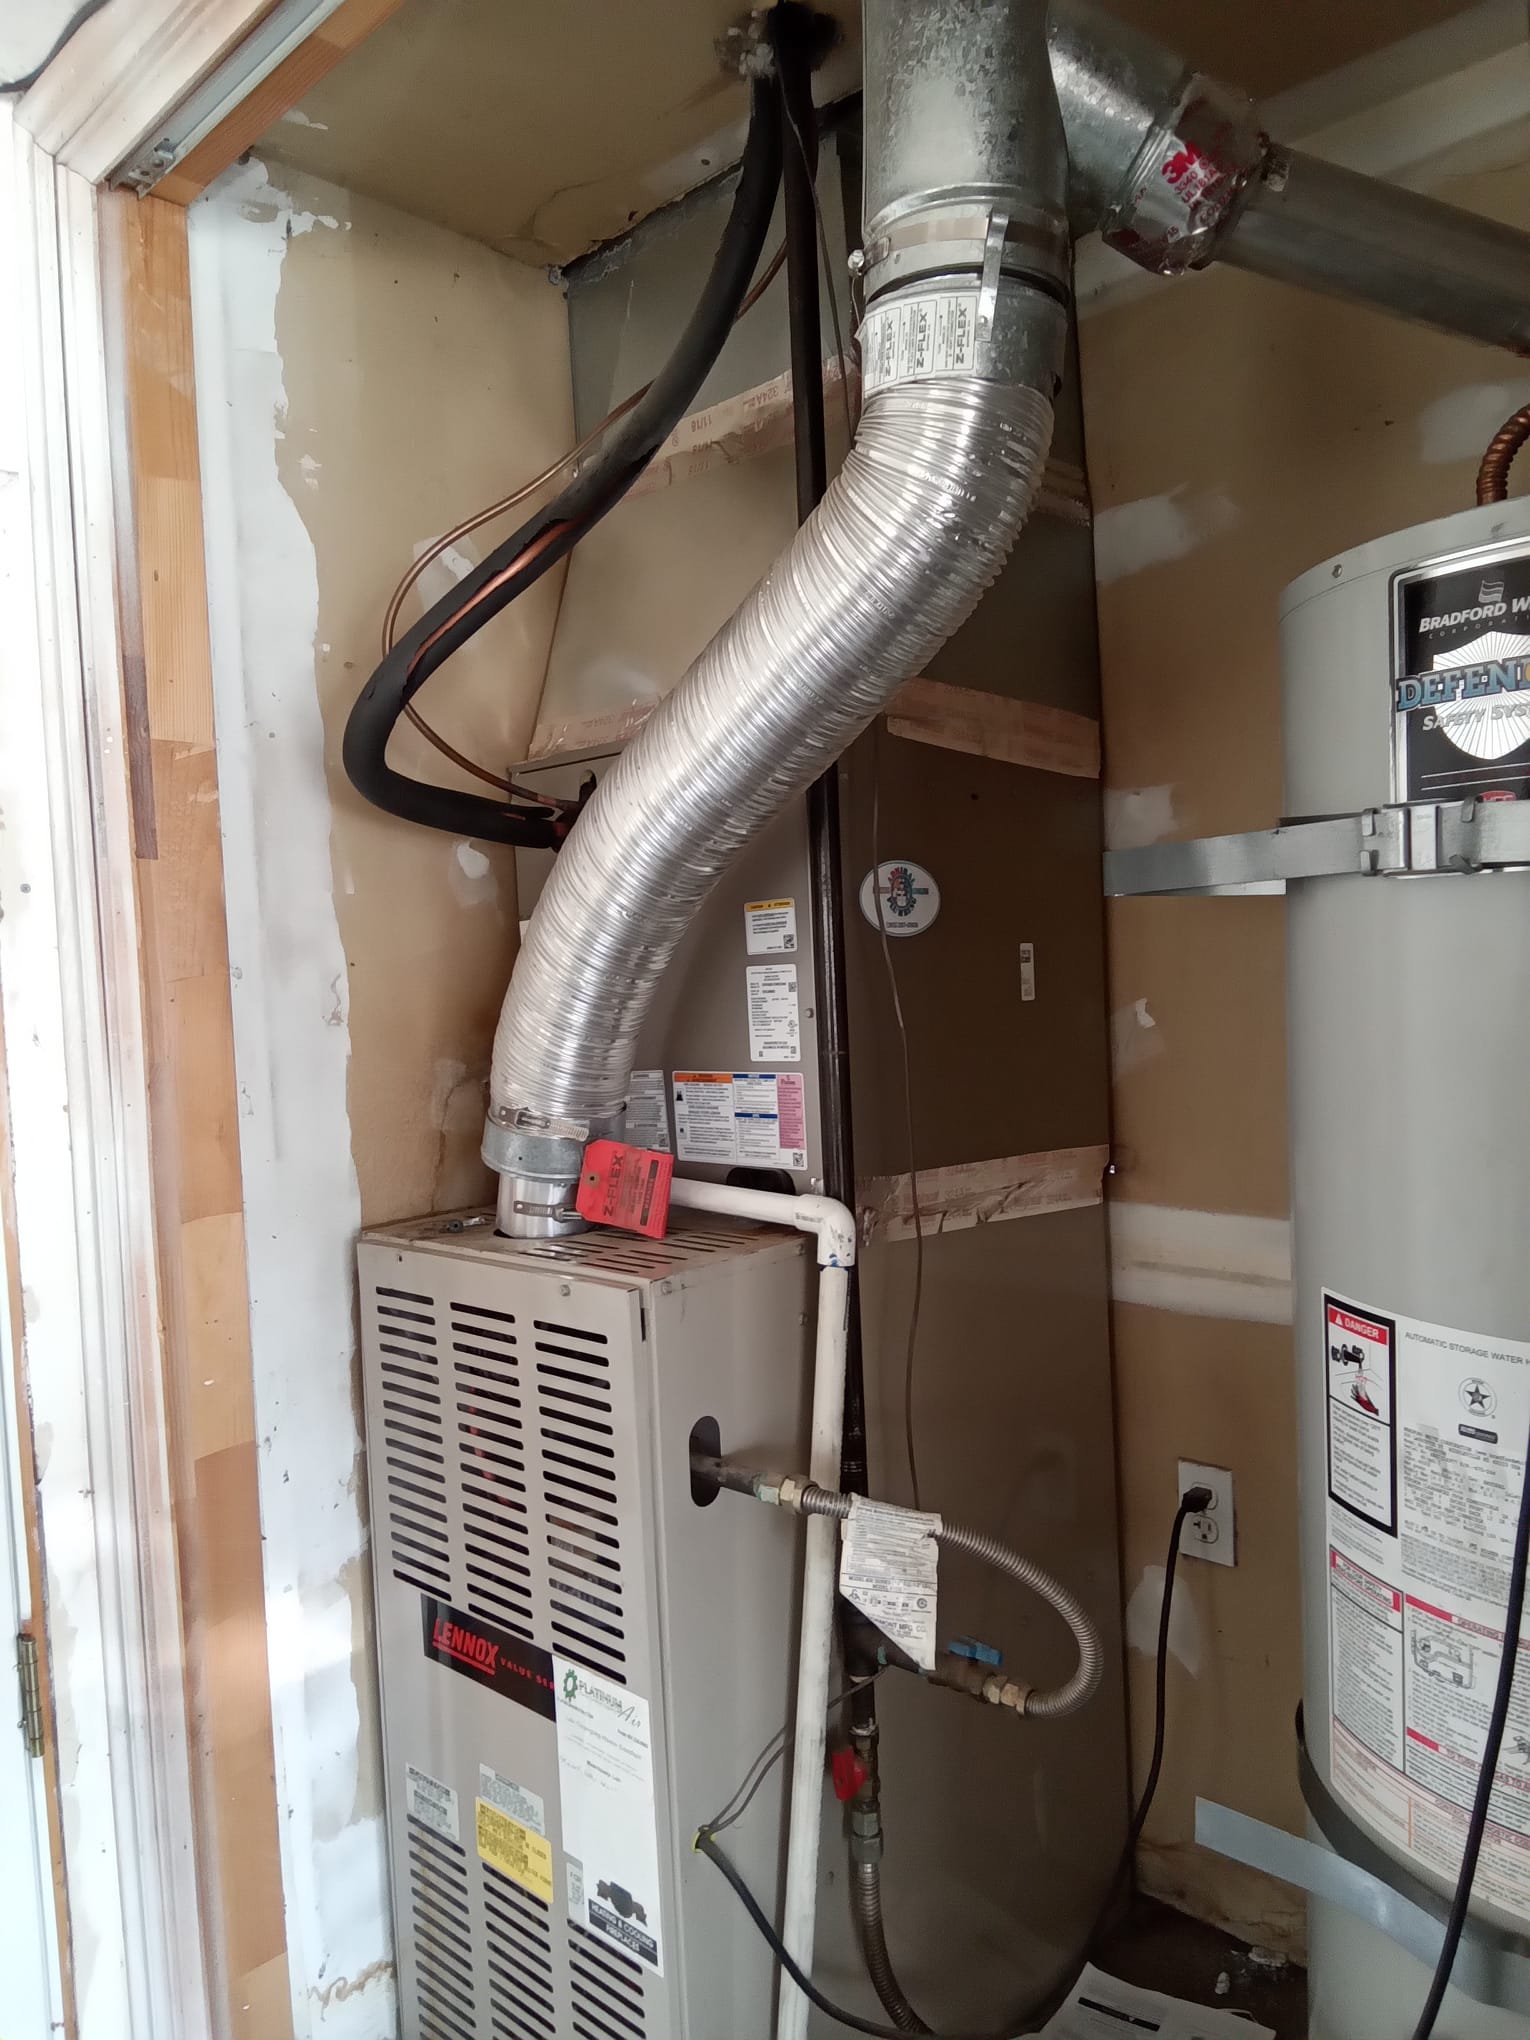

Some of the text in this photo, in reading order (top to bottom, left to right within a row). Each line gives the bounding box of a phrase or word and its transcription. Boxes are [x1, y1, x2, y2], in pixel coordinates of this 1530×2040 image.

[1162, 141, 1202, 184] 3M
[885, 320, 894, 377] Z-FLEX
[916, 311, 928, 369] Z-FLEX
[956, 307, 968, 364] Z-FLEX
[1419, 602, 1507, 633] BRADFORD
[1422, 703, 1530, 731] SAFETY SYS
[603, 1153, 624, 1217] Z-FLEX
[1344, 1317, 1379, 1339] DANGER
[1404, 1331, 1524, 1365] AUTOMATIC STORAGE WATER
[433, 1617, 499, 1669] LENNOX
[501, 1657, 532, 1679] VALUE
[579, 1680, 623, 1709] PLATINUM
